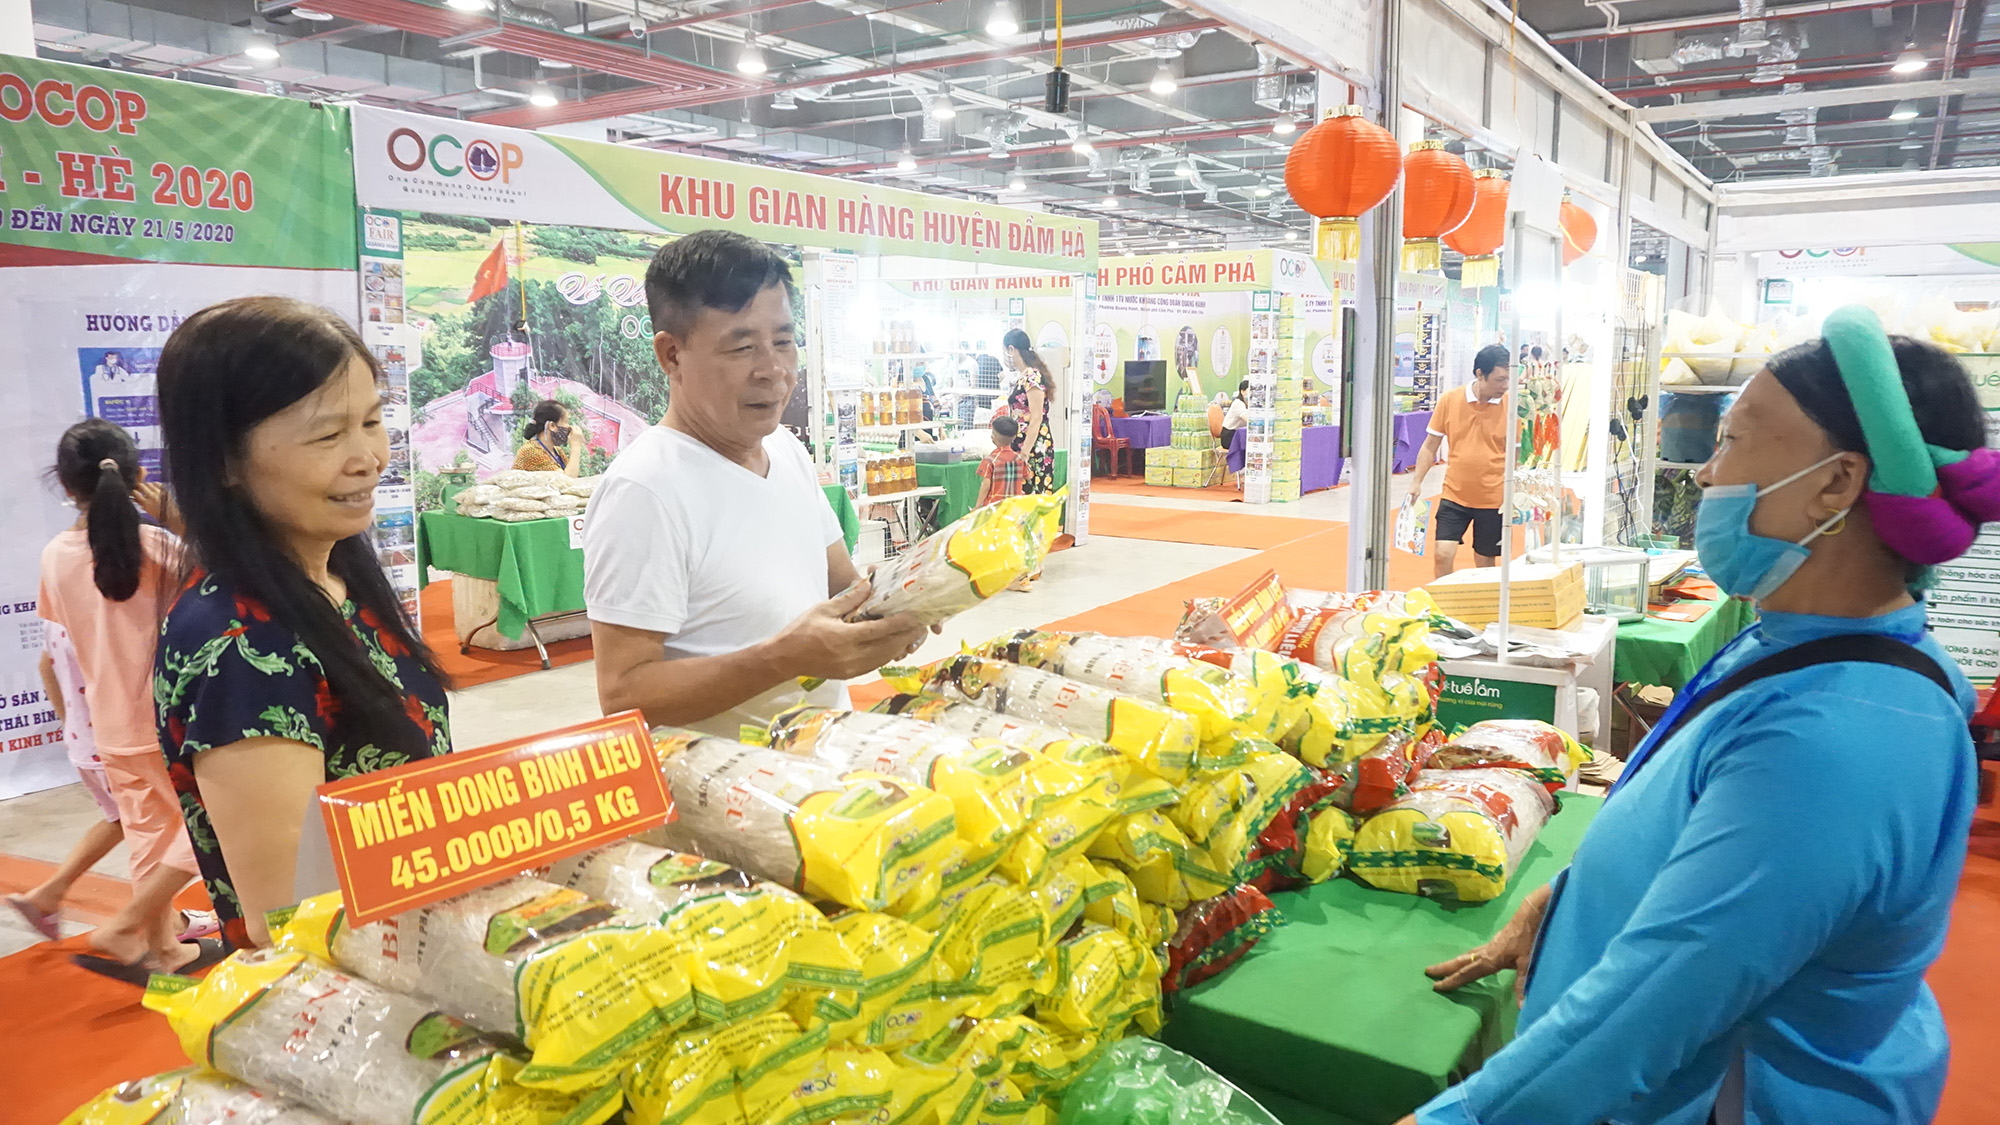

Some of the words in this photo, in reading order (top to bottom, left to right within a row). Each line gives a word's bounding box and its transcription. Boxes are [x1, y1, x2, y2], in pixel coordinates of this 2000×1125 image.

[0, 73, 147, 135] OCOP
[57, 146, 136, 202] HÈ
[150, 162, 255, 212] 2020
[387, 127, 524, 184] OCOP
[11, 205, 62, 232] ĐẾN
[70, 211, 137, 237] NGÀY
[142, 218, 235, 243] 21/5/2020
[368, 227, 395, 241] FAIR
[659, 173, 735, 220] KHU
[749, 186, 827, 231] GIAN
[838, 194, 914, 240] HÀNG
[923, 210, 1001, 256] HUYỆN
[1008, 214, 1054, 257] ĐẦM
[1061, 225, 1086, 259] HÀ
[1116, 258, 1154, 286] PHỐ
[1161, 256, 1206, 285] CẨM
[1214, 254, 1256, 283] PHẢ
[1975, 659, 1998, 669] CHO
[33, 709, 61, 725] BÌN
[8, 734, 43, 752] KINH
[348, 780, 437, 850] MIẾN
[437, 767, 521, 823] DONG
[519, 751, 588, 800] BÌNH
[586, 731, 642, 780] LIÊU
[390, 799, 596, 890] 45.000Đ/0,5
[595, 786, 641, 826] KG
